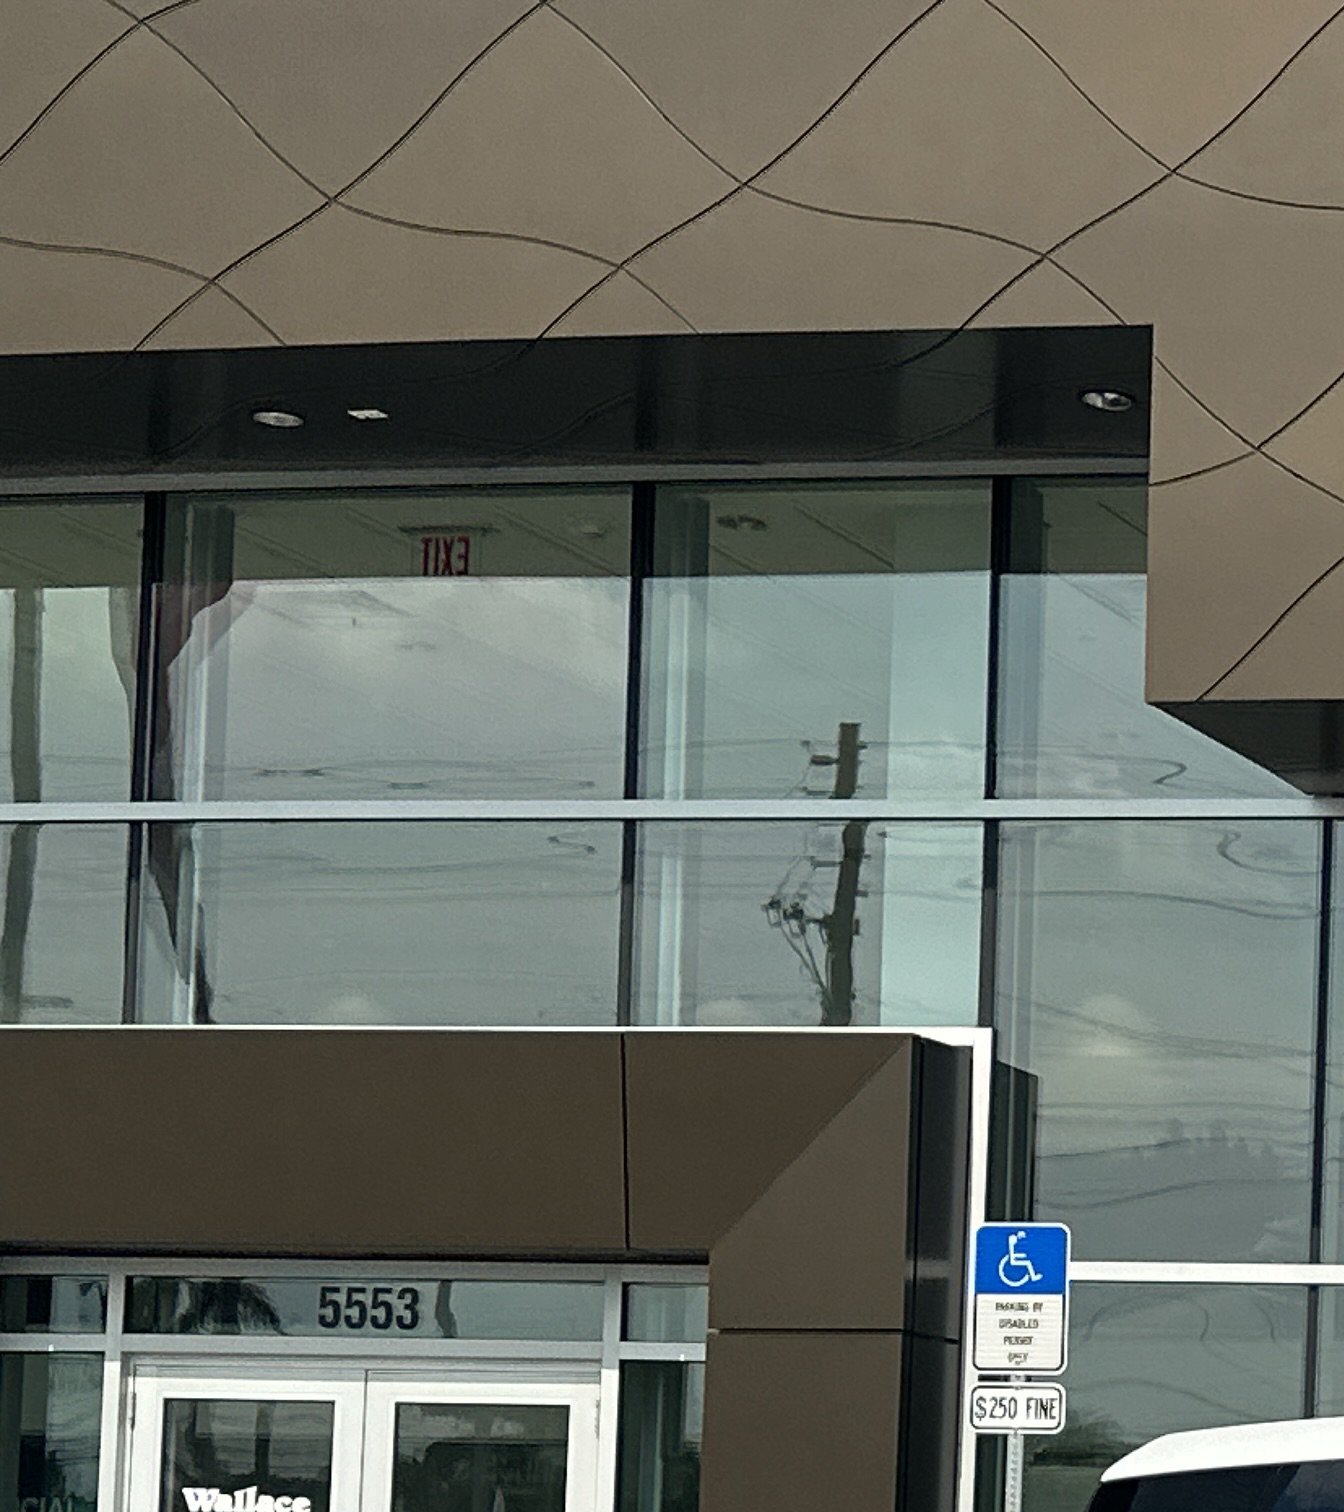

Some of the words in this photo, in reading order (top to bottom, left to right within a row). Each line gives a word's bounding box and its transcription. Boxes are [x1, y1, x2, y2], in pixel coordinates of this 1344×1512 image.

[318, 1285, 421, 1331] 5553
[998, 1318, 1039, 1329] DISABLED
[975, 1396, 1018, 1421] $250
[1026, 1397, 1058, 1420] FINE
